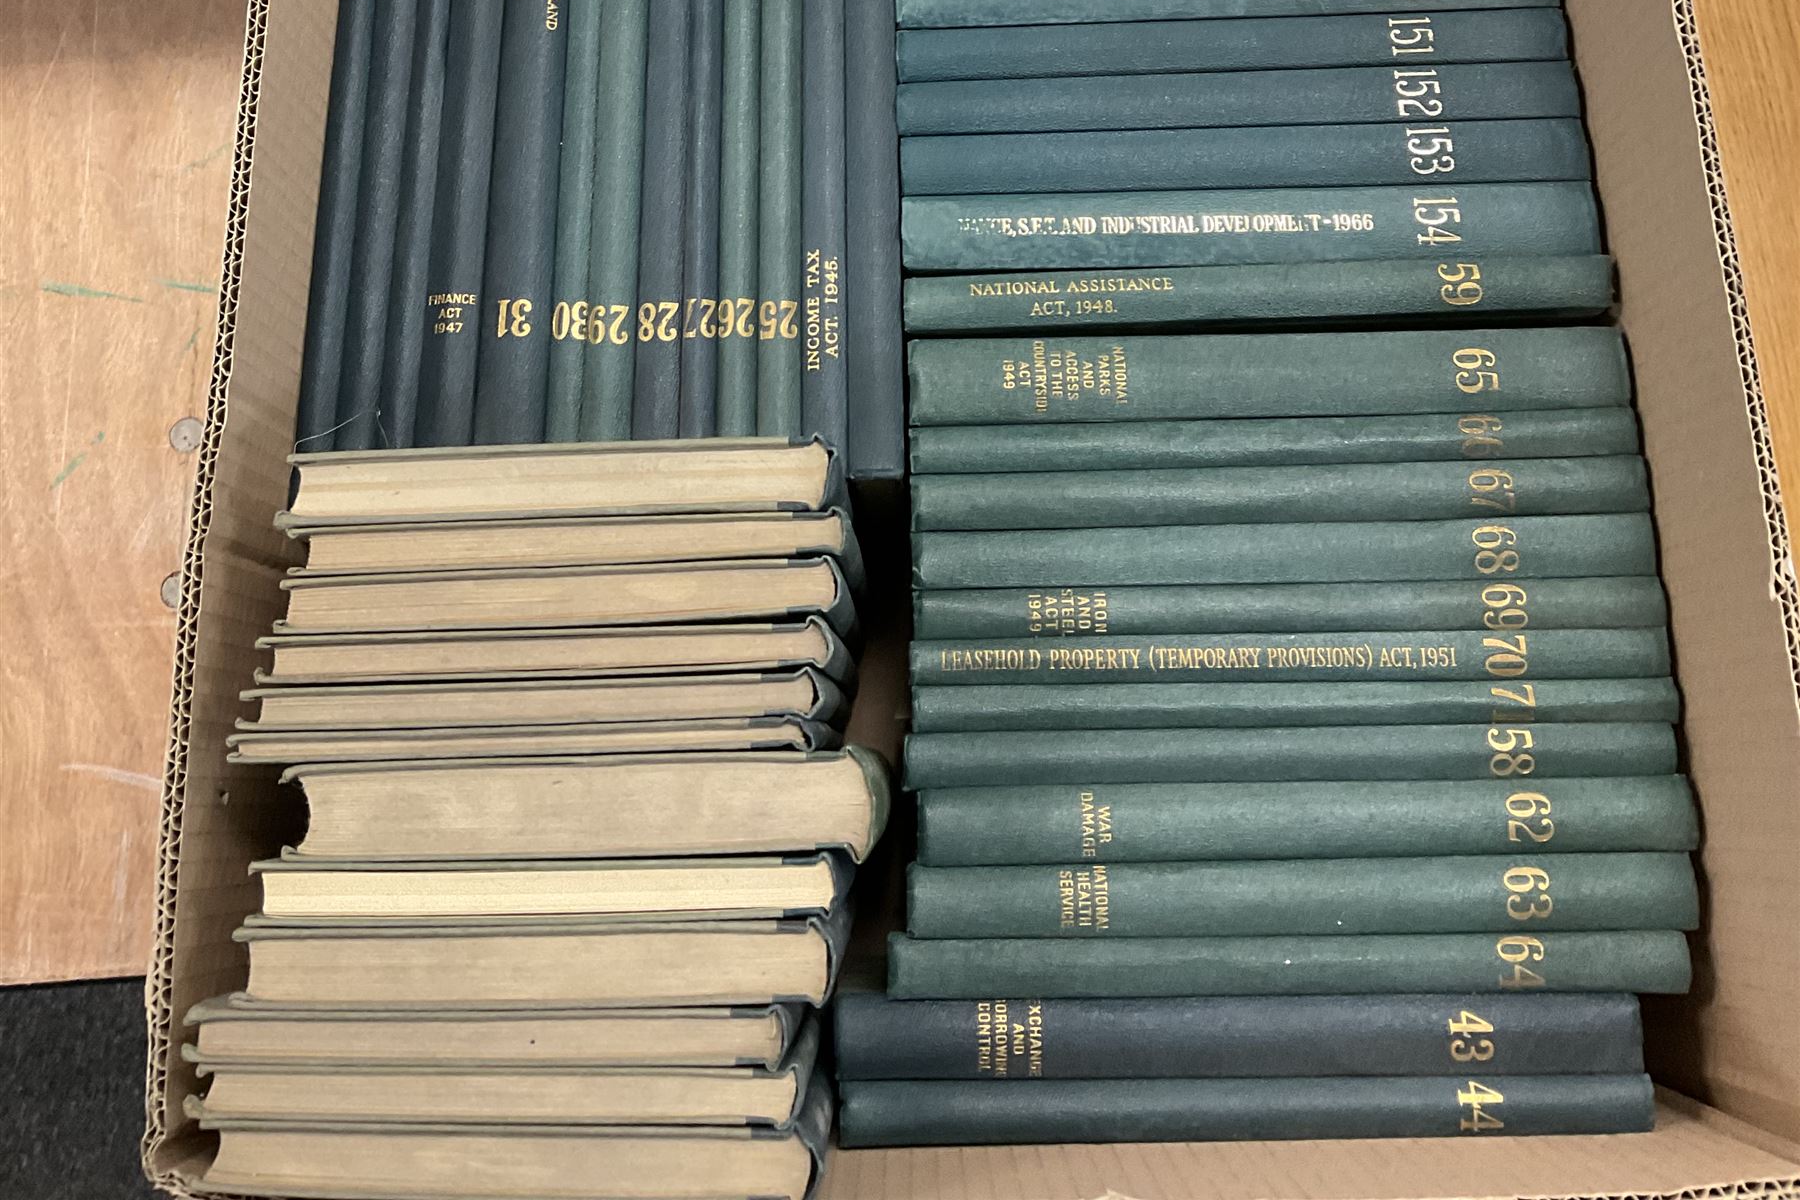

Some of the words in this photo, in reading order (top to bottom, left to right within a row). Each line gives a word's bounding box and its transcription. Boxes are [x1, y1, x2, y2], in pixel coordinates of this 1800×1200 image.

[1388, 17, 1434, 56] 151
[1393, 69, 1443, 117] 152
[1406, 126, 1455, 175] 153
[1414, 196, 1463, 246] 154
[806, 248, 820, 288] TAX
[824, 256, 838, 304] 1945.
[970, 280, 1060, 296] NATIONAL
[1067, 277, 1174, 293] ASSISTANCE
[1437, 263, 1483, 306] 59
[428, 294, 477, 306] FINANCE
[438, 307, 463, 319] ACT
[497, 298, 532, 338] 31
[552, 300, 588, 340] 30
[682, 298, 717, 338] 27
[717, 296, 756, 338] 26
[759, 300, 799, 339] 25
[1029, 300, 1071, 317] ACT,
[1076, 300, 1118, 315] 1948.
[433, 321, 464, 334] 1947
[586, 304, 630, 345] 29
[638, 301, 677, 341] 28
[807, 296, 820, 371] INCOME
[825, 316, 839, 358] ACT.
[1003, 359, 1015, 390] 1949
[1019, 361, 1031, 388] ACT
[1050, 353, 1062, 367] TO
[1065, 350, 1079, 401] ACCESS
[1082, 361, 1095, 388] AND
[1097, 355, 1111, 396] PARKS
[1452, 347, 1500, 394] 65
[1051, 372, 1063, 399] THE
[1468, 469, 1516, 513] 67
[1471, 525, 1520, 575] 68
[1028, 594, 1042, 632] 1949
[1044, 596, 1058, 630] ACT
[1061, 588, 1075, 637] STEEL
[1077, 596, 1091, 629] AND
[1093, 592, 1108, 633] IRON
[1481, 583, 1528, 631] 69
[940, 648, 1041, 671] LEASEHOLD
[1049, 648, 1140, 670] PROPERTY
[1149, 645, 1261, 672] (TEMPORARY
[1267, 643, 1373, 671] PROVISIONS)
[1482, 634, 1527, 677] 70
[1487, 727, 1535, 776] 58
[1080, 792, 1095, 857] DAMAGE
[1097, 806, 1112, 843] WAR
[1505, 791, 1555, 843] 62
[1059, 870, 1075, 928] SERVICE
[1076, 872, 1092, 927] HEALTH
[1503, 865, 1553, 921] 63
[1496, 935, 1546, 989] 64
[1012, 1023, 1025, 1055] AND
[1448, 1010, 1495, 1063] 43
[1458, 1080, 1504, 1132] 44
